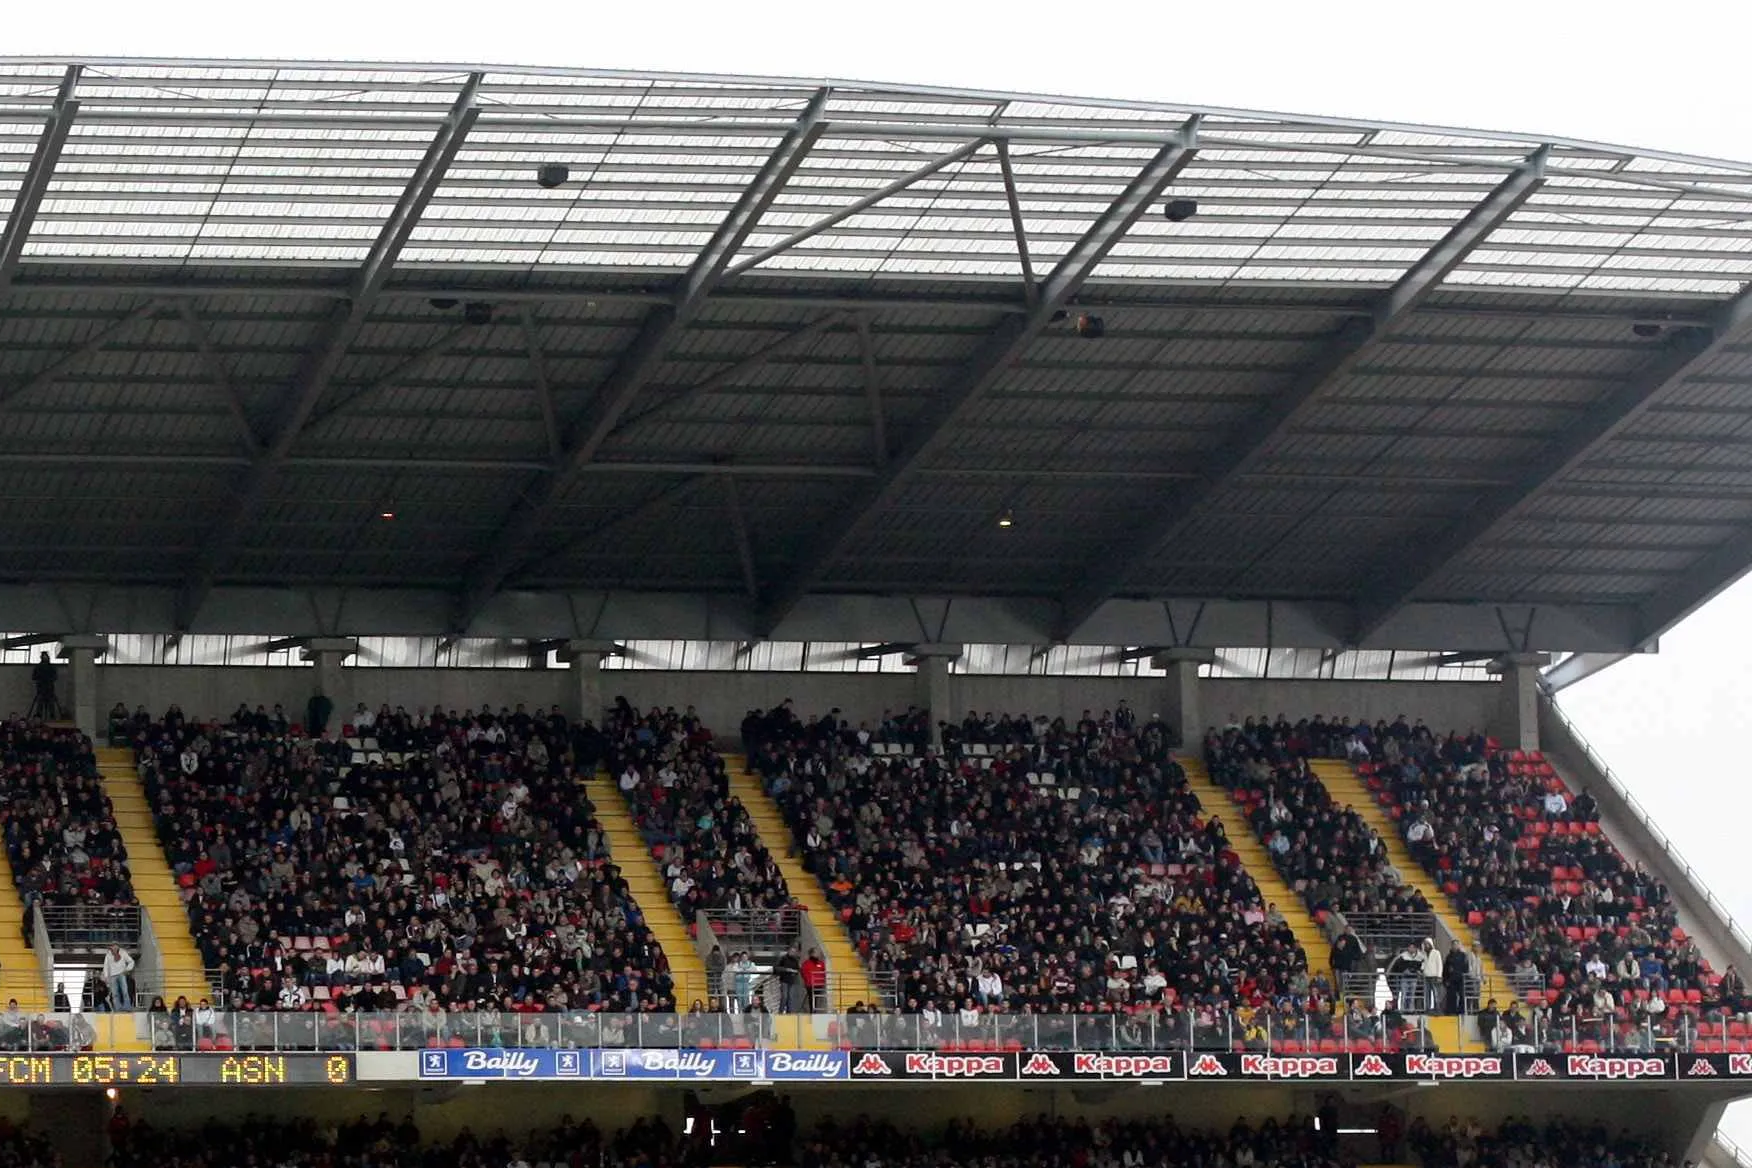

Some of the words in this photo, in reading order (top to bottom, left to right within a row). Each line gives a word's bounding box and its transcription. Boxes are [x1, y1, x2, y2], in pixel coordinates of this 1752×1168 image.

[72, 1056, 179, 1083] 05:24
[222, 1056, 284, 1083] ASN
[327, 1056, 347, 1083] 0
[464, 1051, 538, 1076] Bailly
[642, 1052, 716, 1076] Bailly
[768, 1053, 843, 1077] Bailly
[905, 1053, 1004, 1075] Kappa
[1074, 1053, 1171, 1075] Kappa
[1241, 1054, 1336, 1076] Kappa
[1405, 1054, 1500, 1076] Kappa
[1568, 1055, 1665, 1076] Kappa
